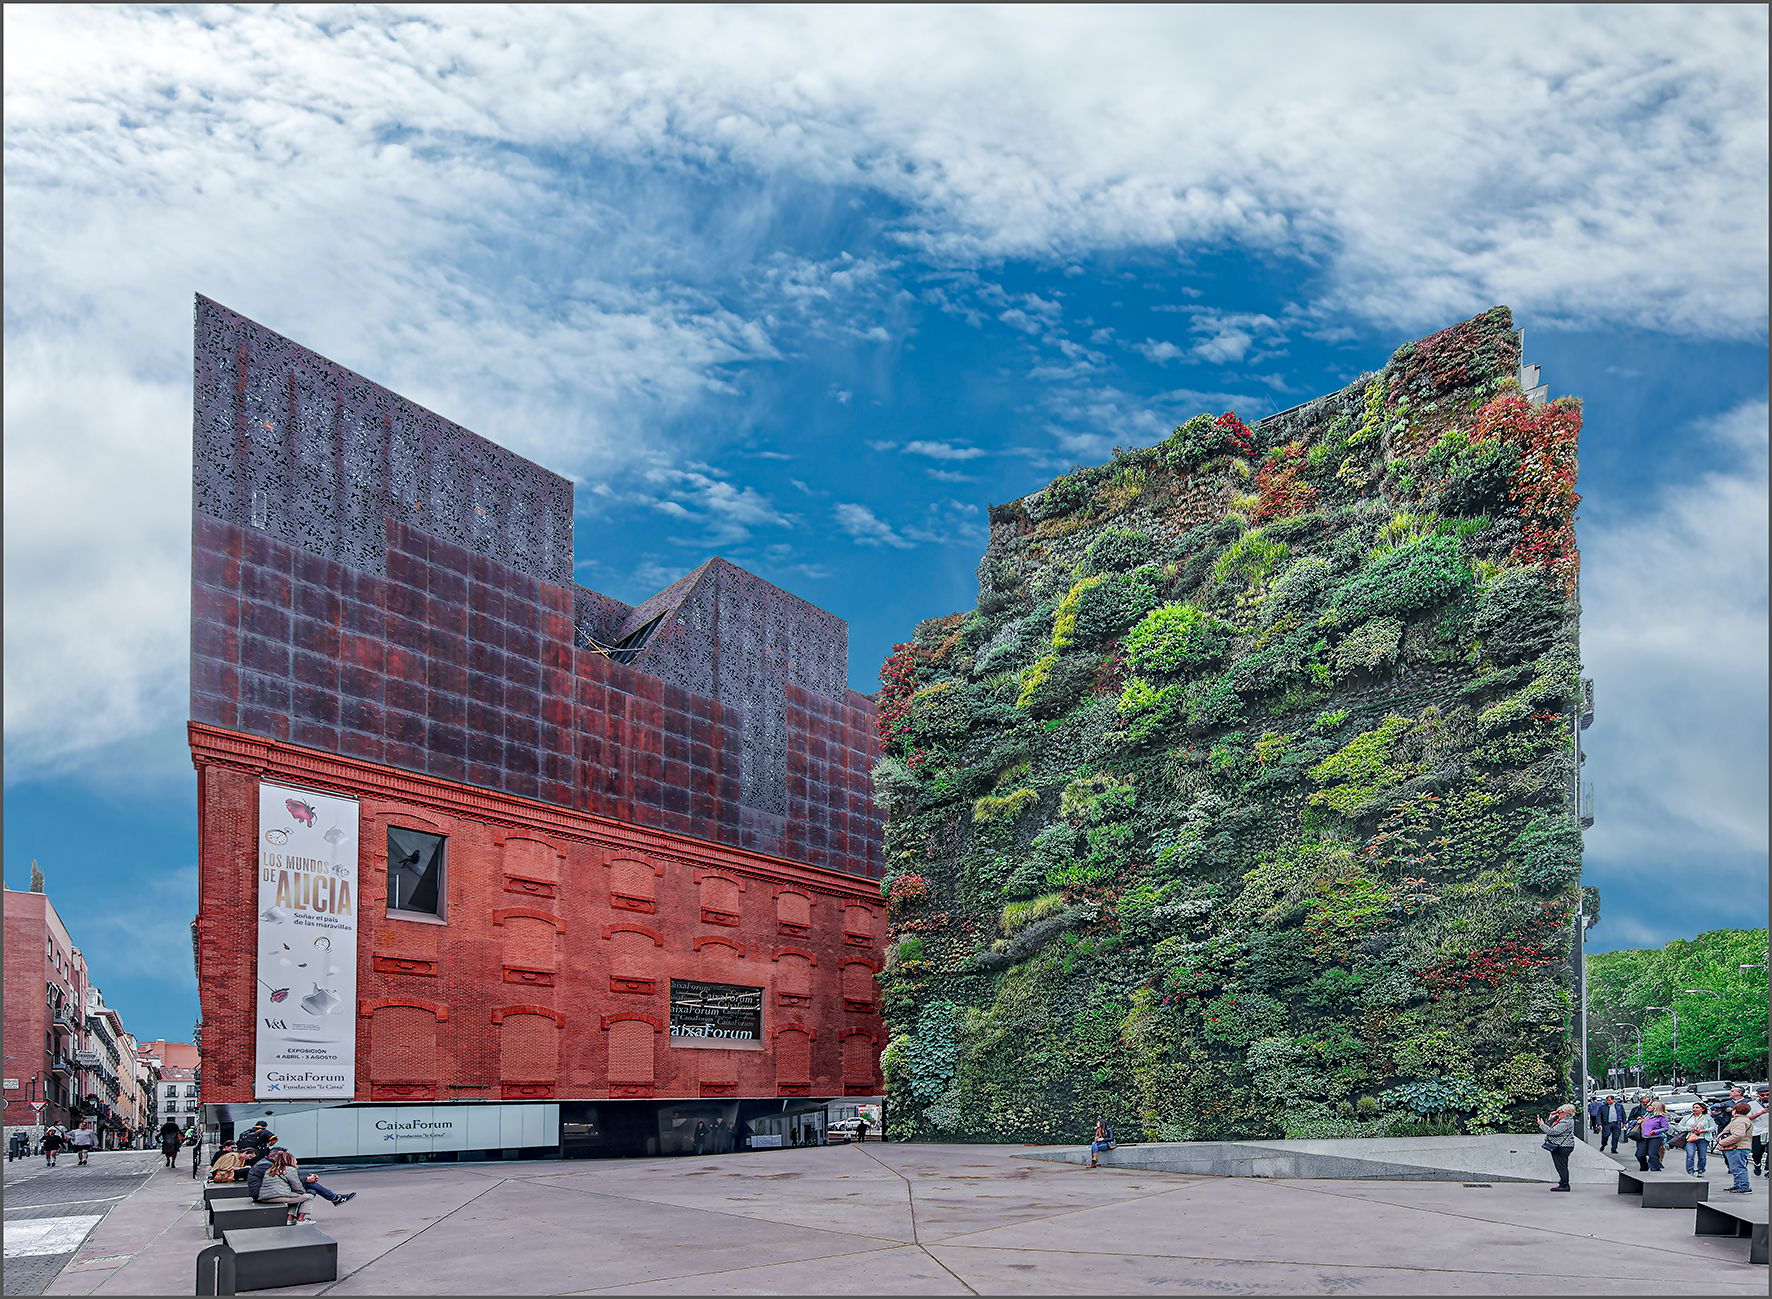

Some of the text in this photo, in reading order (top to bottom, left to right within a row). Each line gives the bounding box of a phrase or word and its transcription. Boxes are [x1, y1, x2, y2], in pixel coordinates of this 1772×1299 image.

[262, 852, 329, 874] LOS MUNDOS
[263, 868, 276, 882] DE
[275, 870, 352, 916] ALICIA
[316, 922, 352, 930] maravillas
[671, 981, 711, 991] aixaForum
[670, 1005, 720, 1016] aixaForum
[264, 1018, 288, 1030] V&A
[670, 1024, 752, 1040] aixaForum
[267, 1072, 345, 1082] CaixaForum
[376, 1120, 452, 1130] CaixaForum
